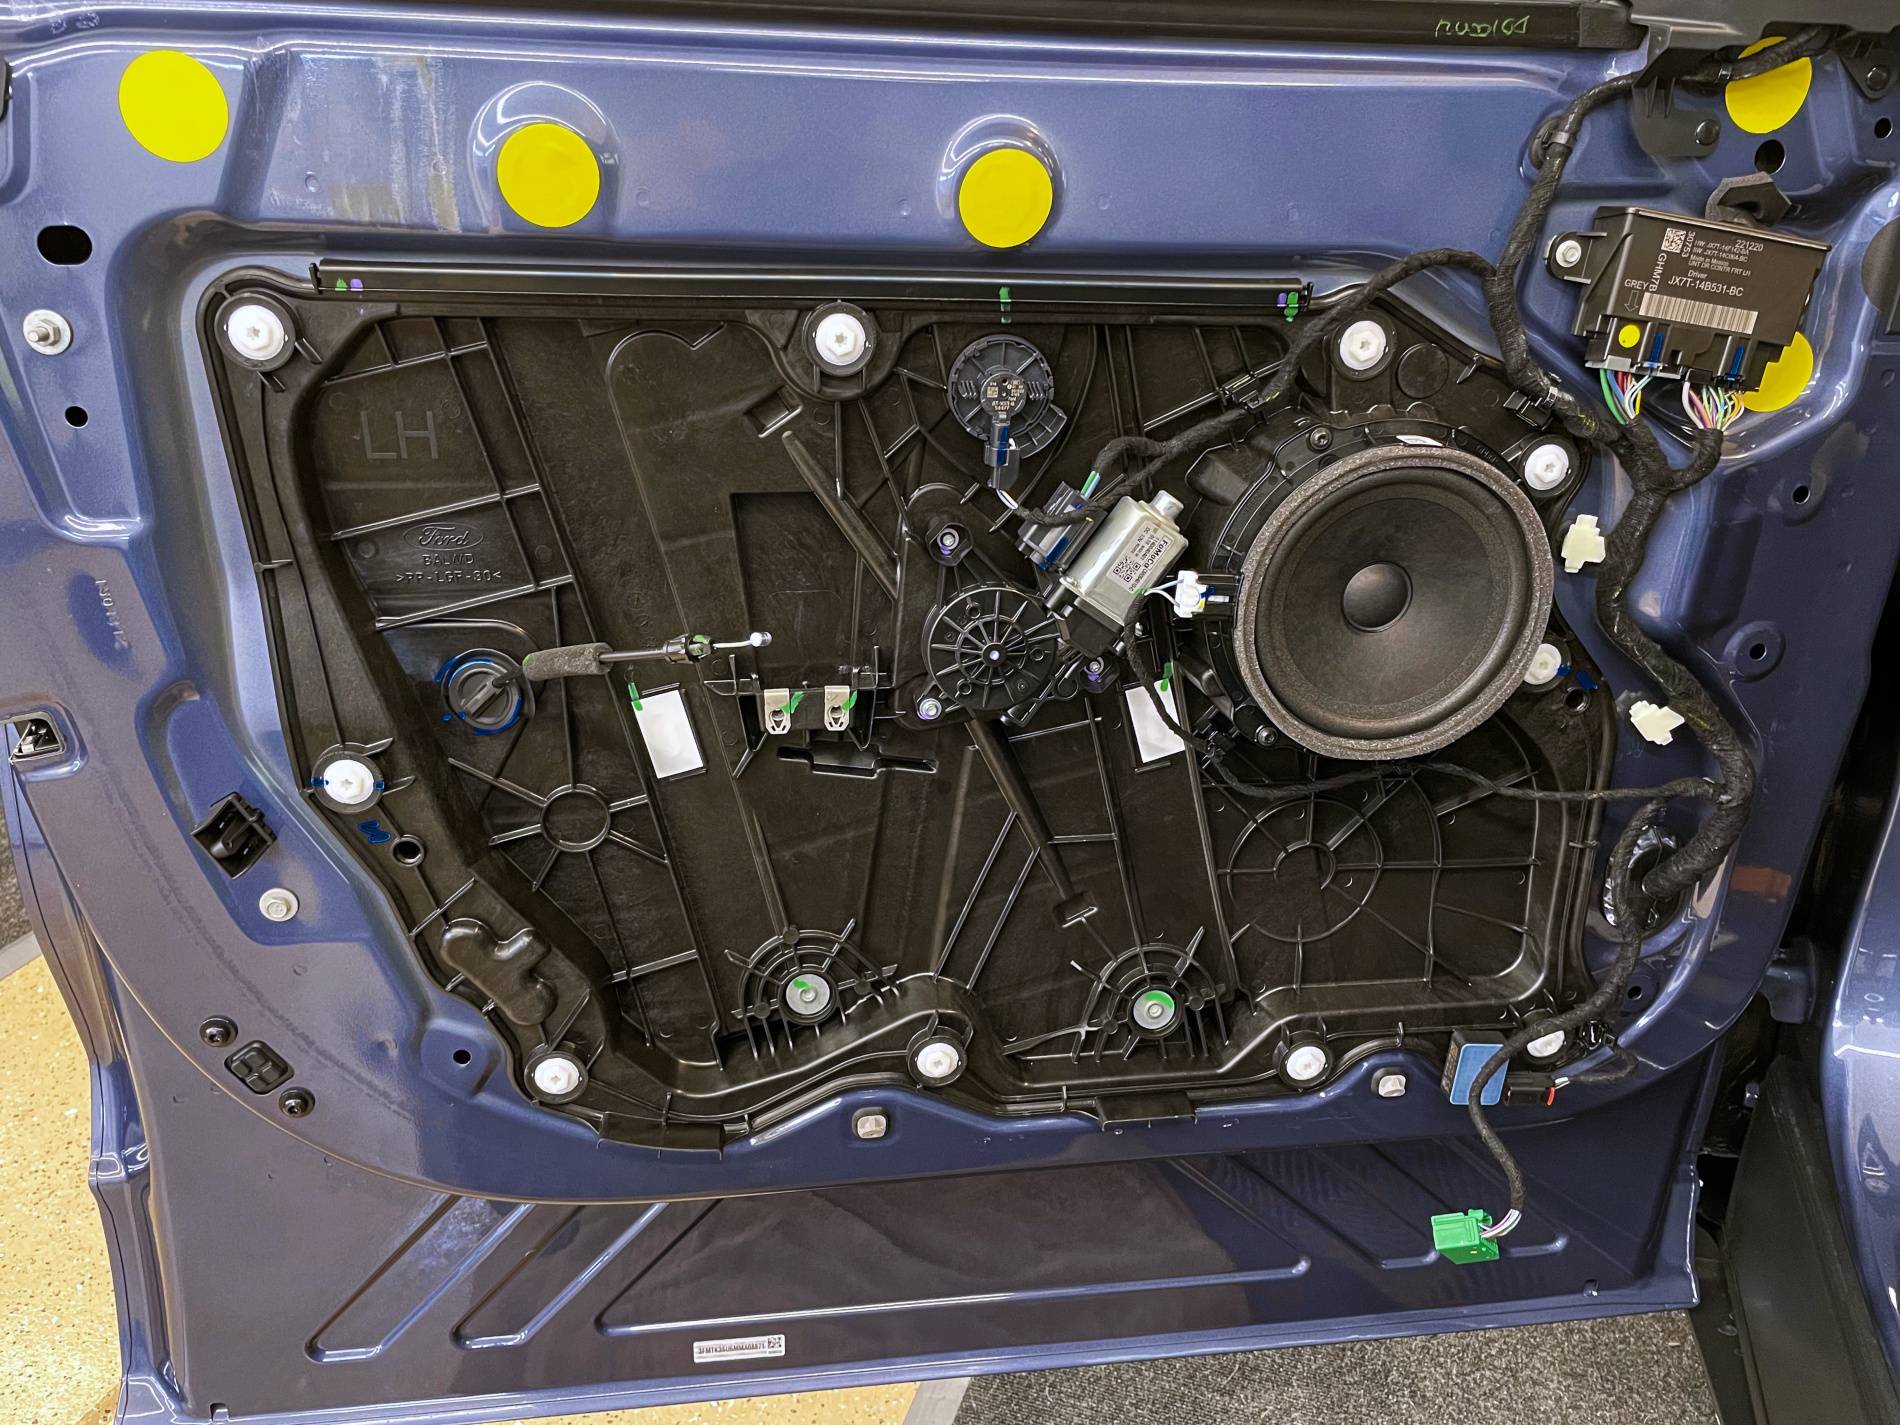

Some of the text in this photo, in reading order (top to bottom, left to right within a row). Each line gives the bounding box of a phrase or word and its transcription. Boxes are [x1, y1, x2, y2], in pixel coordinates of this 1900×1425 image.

[1681, 230, 1695, 258] 30753
[1735, 239, 1763, 252] 221220
[1648, 252, 1667, 292] GHM7B
[1687, 269, 1707, 279] Driver
[1710, 264, 1730, 272] CONTR
[1624, 279, 1648, 290] GREY
[1668, 275, 1743, 296] JX7T-14B531-BC
[360, 410, 439, 460] LH
[418, 526, 470, 546] Ford
[1143, 539, 1167, 568] FoMoCo
